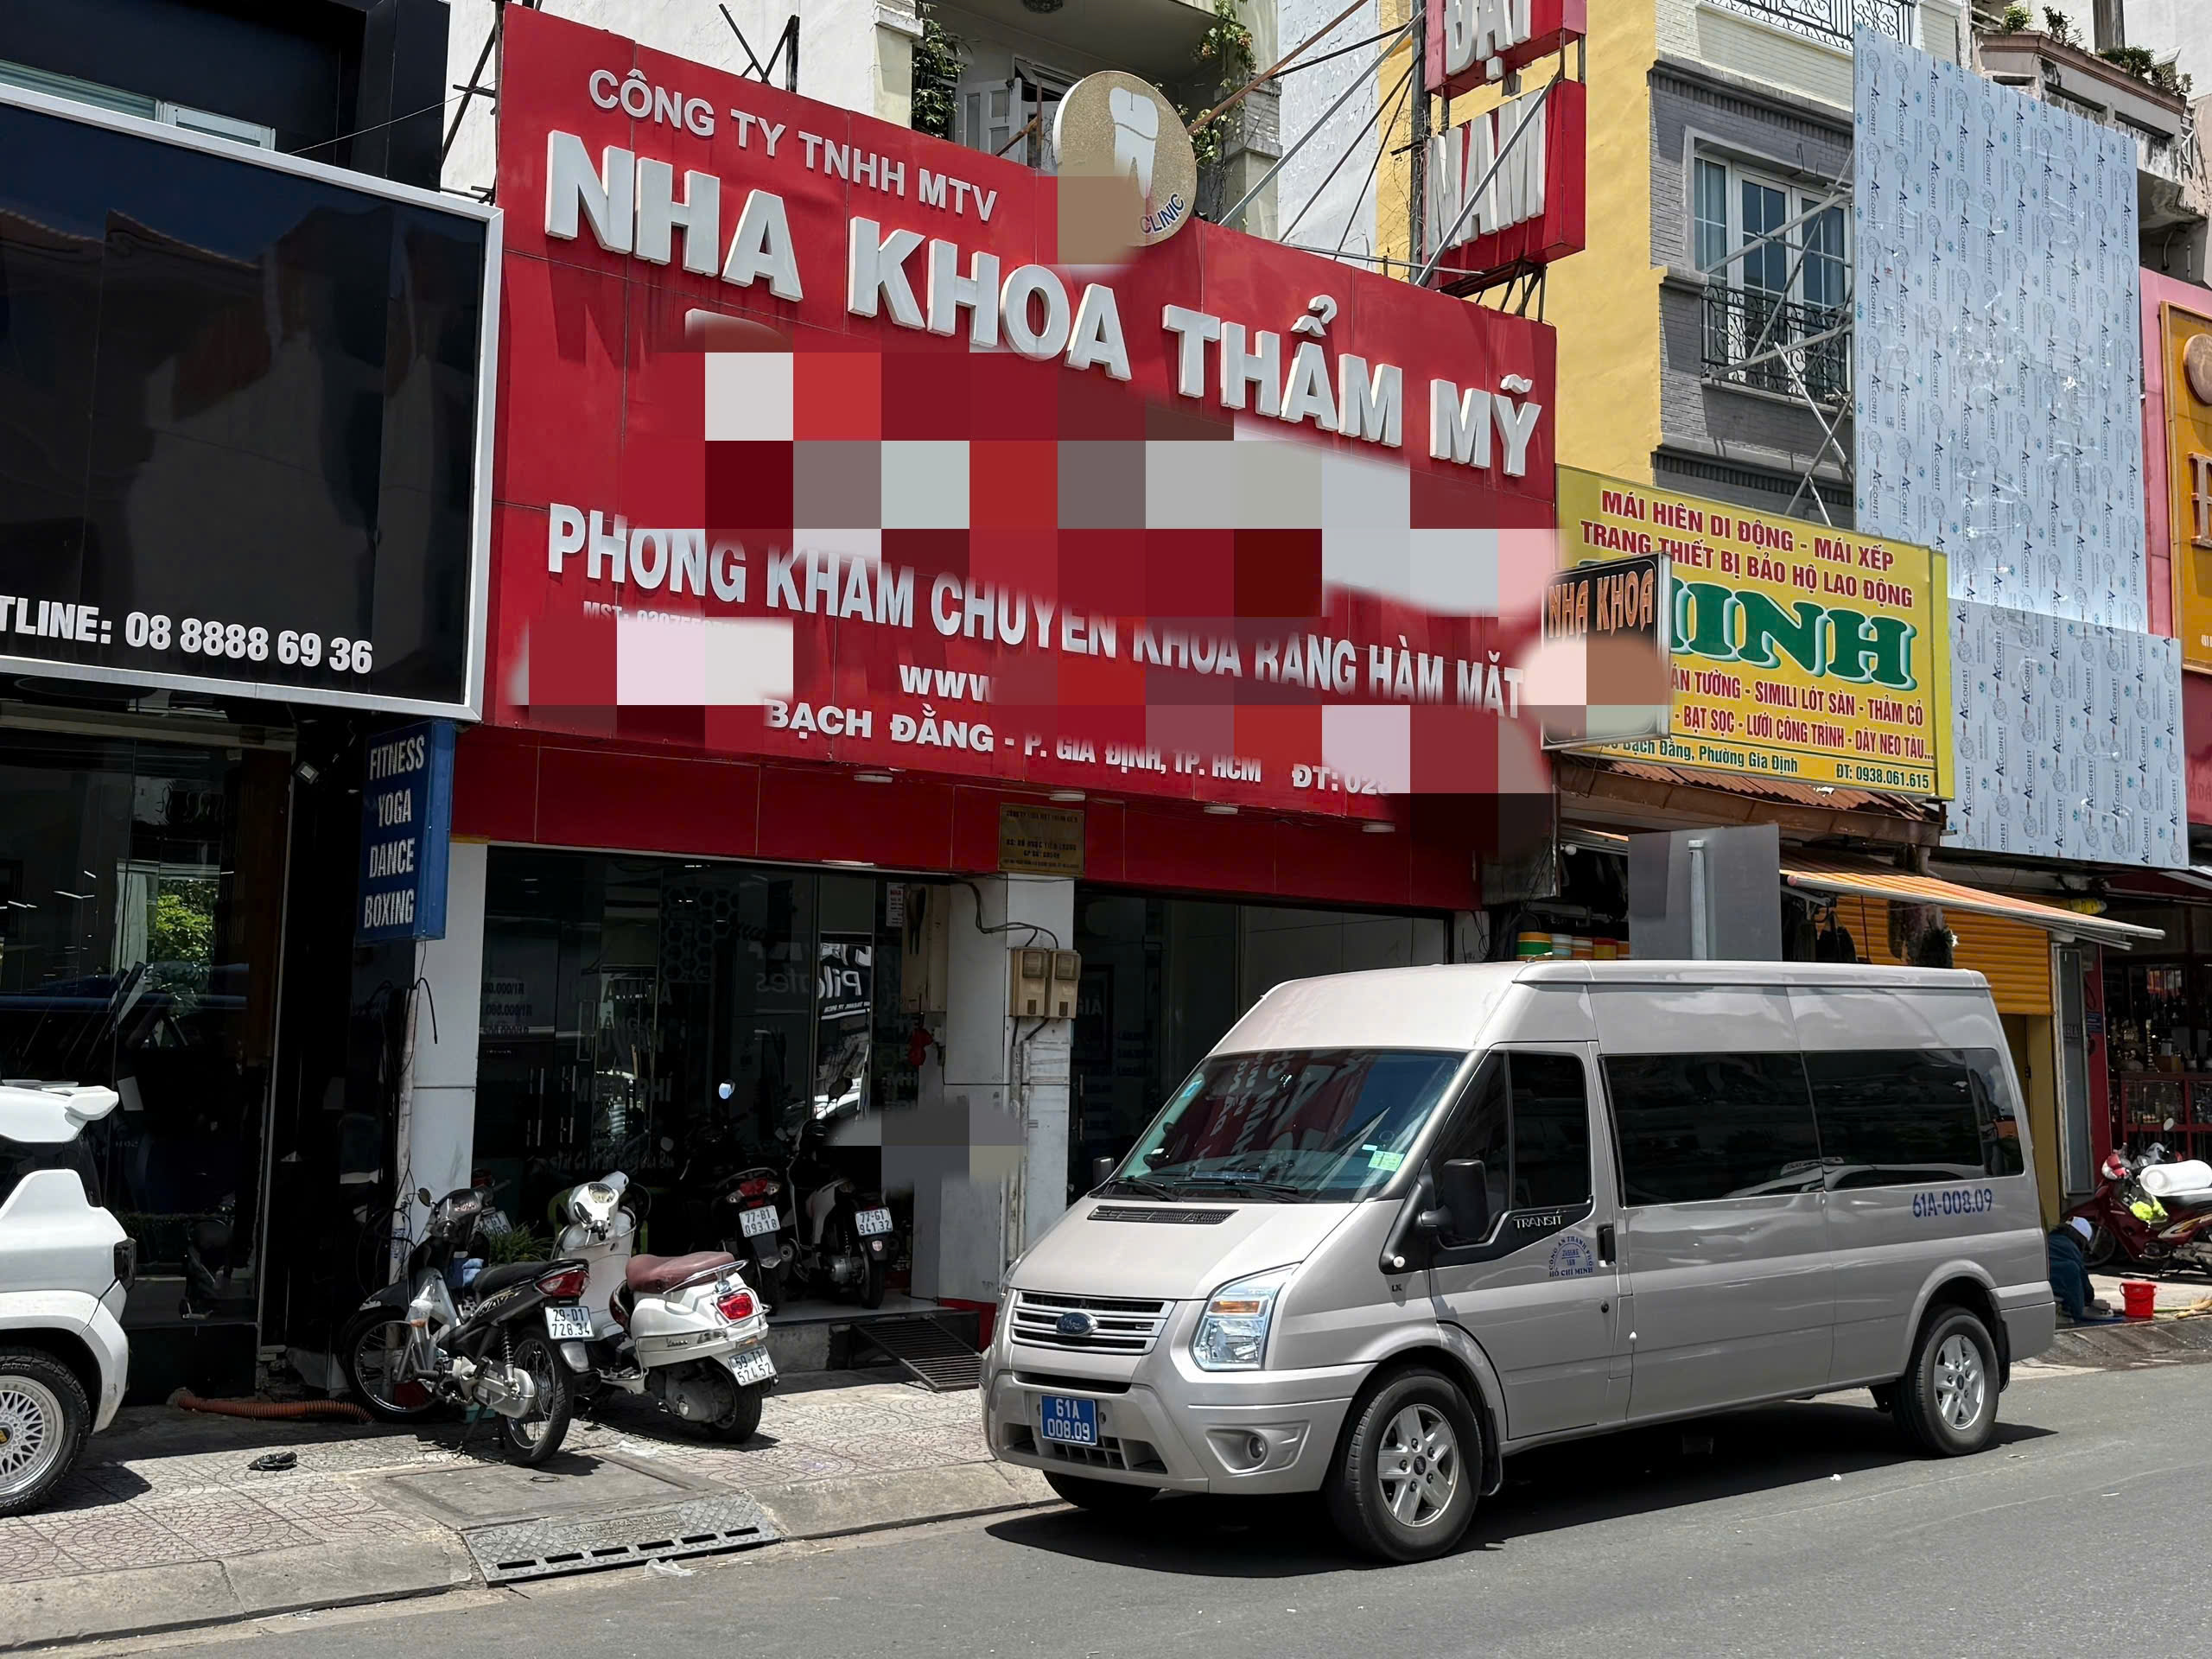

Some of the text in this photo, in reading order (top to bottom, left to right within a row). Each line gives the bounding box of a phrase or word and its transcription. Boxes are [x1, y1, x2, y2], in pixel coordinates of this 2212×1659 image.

[588, 68, 998, 222] CÔNG TY TNHH MTV
[1427, 90, 1546, 256] NAM
[1139, 192, 1185, 234] CLINIC
[545, 130, 1541, 477] NHA KHOA THẨM MỸ
[1602, 490, 1644, 520] MÁI
[1653, 503, 1702, 533] HIÊN
[1710, 515, 1731, 539] DI
[1738, 518, 1794, 551] ĐỘNG
[1815, 537, 1852, 563] MÁI
[1858, 543, 1894, 572] XẾP
[1580, 520, 1913, 607] TRANG THIẾT BỊ BẢO HỘ LAO ĐỘNG
[1548, 569, 1654, 640] NHA KHOA
[125, 611, 172, 650] 08
[180, 617, 269, 662] 8888
[276, 629, 321, 667] 69
[328, 637, 373, 674] 36
[1369, 634, 1443, 705] HÀM
[1694, 669, 1740, 699] TƯỜNG
[1755, 680, 1797, 708] SIMILI
[1802, 685, 1824, 711] LÓT
[1828, 690, 1855, 716] SÀN
[1867, 694, 1903, 723] THẢM
[1907, 699, 1923, 726] CỎ
[764, 698, 872, 740] BẠCH
[890, 703, 994, 753] ĐẰNG
[1025, 733, 1047, 758] P.
[1056, 734, 1096, 763] GIA
[1105, 740, 1166, 774] ĐỊNH,
[1173, 748, 1205, 776] TP.
[1211, 753, 1262, 783] HCM
[1291, 763, 1338, 791] ĐT:
[1684, 705, 1707, 734] BẠT
[1711, 709, 1734, 736] SỌC
[1746, 712, 1772, 739] LƯỚI
[1777, 715, 1808, 743] CÔNG
[1811, 721, 1845, 748] TRÌNH
[1855, 727, 1876, 753] DÂY
[1879, 733, 1901, 756] NEO
[369, 734, 425, 780] FITNESS
[1659, 737, 1694, 761] Đằng,
[1699, 745, 1745, 767] Phường
[1748, 751, 1768, 769] Gia
[1771, 754, 1798, 774] Định
[1836, 763, 1929, 789] ĐT: 0938.061.615
[378, 788, 412, 828] YOGA
[368, 837, 416, 879] DANCE
[364, 888, 415, 929] BOXING
[746, 1209, 771, 1224] 77-B1
[1513, 1215, 1562, 1229] TRANSIT
[1912, 1188, 1993, 1217] 61A-008.09
[744, 1218, 778, 1236] 093.18
[551, 1322, 590, 1337] 728.34
[553, 1308, 584, 1322] 29-D1
[734, 1350, 764, 1370] 59-T1
[1047, 1418, 1090, 1441] 008.09
[1056, 1398, 1080, 1420] 61A
